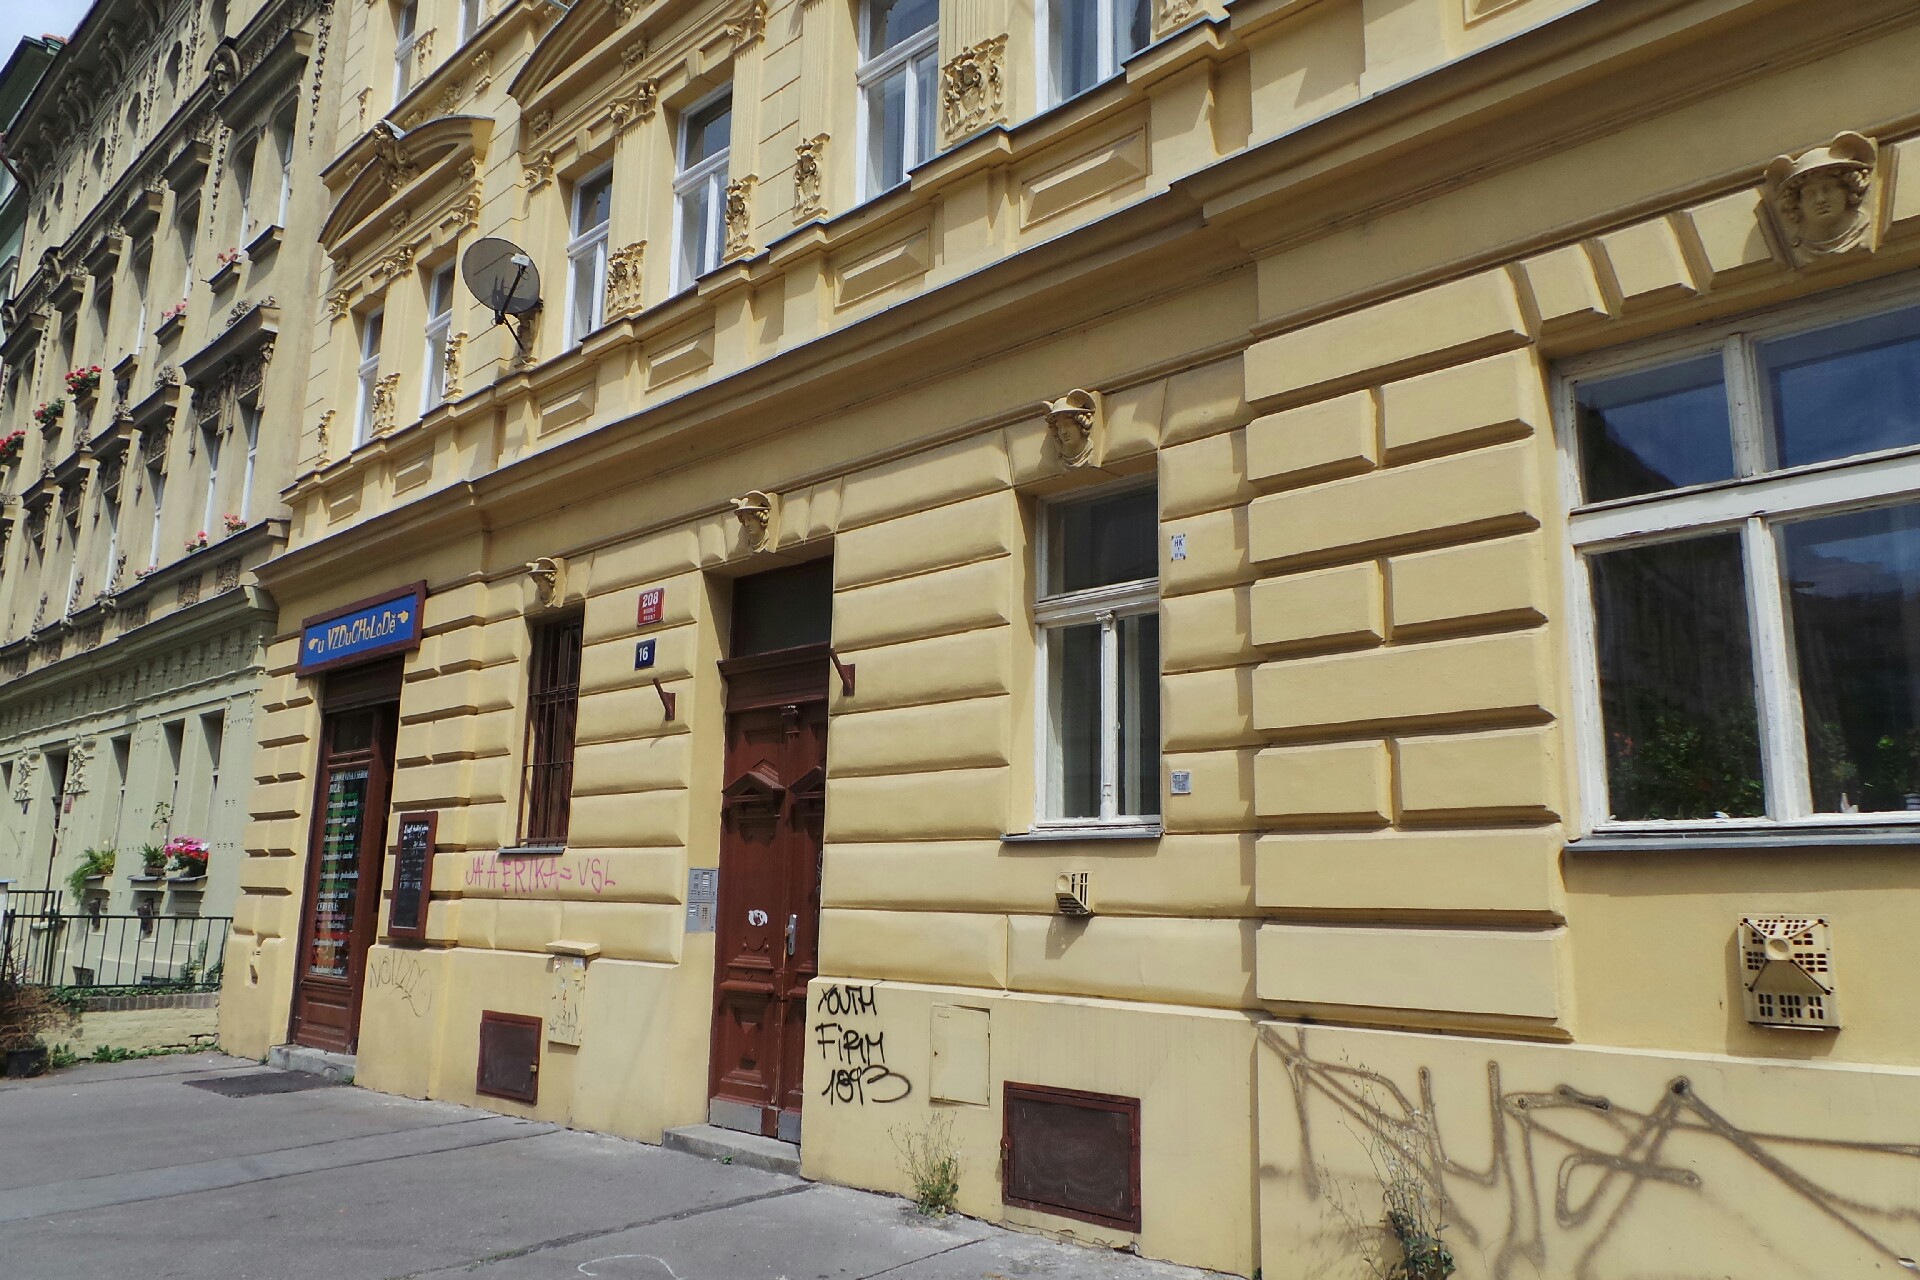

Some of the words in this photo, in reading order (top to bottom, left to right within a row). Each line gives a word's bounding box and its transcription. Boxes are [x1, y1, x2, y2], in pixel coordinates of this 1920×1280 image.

[1174, 538, 1183, 547] HK
[642, 592, 658, 608] 208
[639, 647, 648, 662] 16
